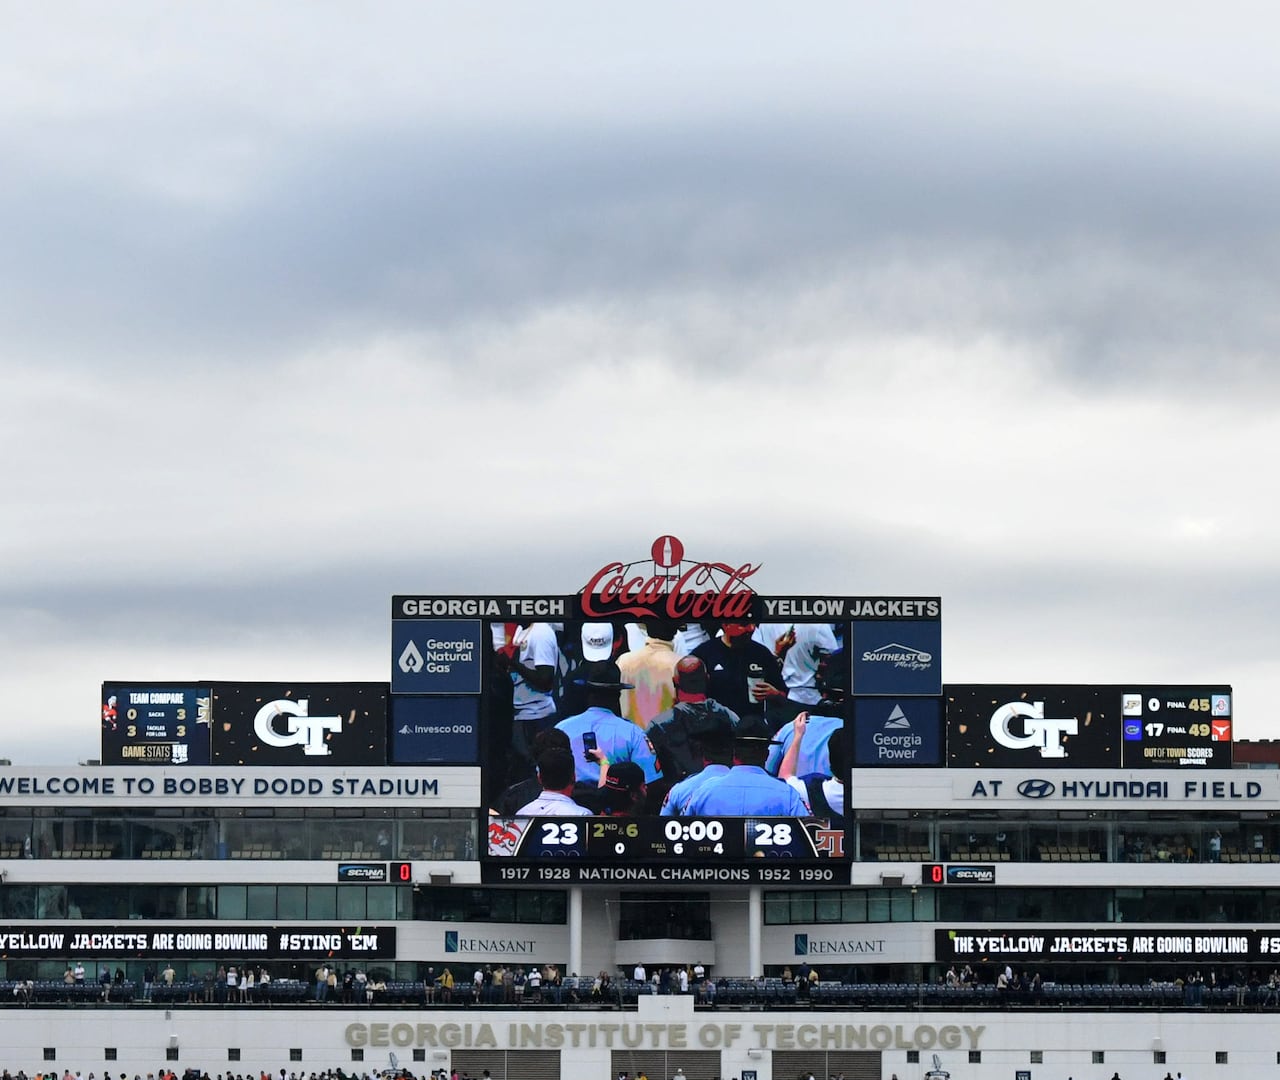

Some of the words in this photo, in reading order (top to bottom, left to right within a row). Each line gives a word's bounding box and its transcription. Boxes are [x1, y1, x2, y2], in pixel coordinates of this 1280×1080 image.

[402, 600, 500, 616] GEORGIA
[509, 600, 565, 616] TECH
[764, 600, 846, 617] YELLOW
[850, 600, 940, 617] JACKETS
[426, 639, 474, 651] Georgia
[426, 651, 473, 661] Natural
[426, 663, 450, 673] Gas
[130, 693, 150, 704] TEAM
[151, 693, 184, 704] COMPARE
[1148, 698, 1160, 711] 0
[1189, 699, 1210, 711] 45
[127, 709, 137, 720] 0
[177, 709, 186, 720] 3
[127, 725, 137, 737] 3
[177, 725, 186, 737] 3
[414, 725, 451, 734] Invesco
[452, 725, 473, 735] QQQ
[1145, 723, 1163, 737] 17
[1189, 724, 1210, 737] 49
[872, 733, 922, 748] Georgia
[122, 746, 145, 758] GAME
[146, 746, 170, 758] STATS
[879, 746, 917, 759] Power
[1144, 748, 1157, 758] OUT
[1157, 748, 1166, 758] OF
[1166, 748, 1186, 758] TOWN
[1187, 748, 1213, 758] SCORES
[122, 777, 155, 795] TO
[163, 777, 245, 796] BOBBY
[253, 778, 324, 796] DODD
[331, 778, 440, 797] STADIUM
[972, 780, 1003, 797] AT
[1062, 781, 1168, 798] HYUNDAI
[1185, 781, 1262, 798] FIELD
[541, 823, 578, 845] 23
[626, 823, 638, 838] 6
[665, 820, 724, 841] 0:00
[754, 823, 792, 845] 28
[615, 842, 625, 855] 0
[673, 842, 683, 855] 6
[714, 842, 724, 855] 4
[347, 869, 385, 877] SCANA
[400, 864, 409, 880] 0
[500, 868, 530, 880] 1917
[538, 868, 571, 880] 1928
[579, 868, 657, 880] NATIONAL
[660, 869, 750, 881] CHAMPIONS
[758, 869, 791, 881] 1952
[799, 869, 833, 881] 1990
[932, 866, 942, 882] 0
[956, 870, 993, 878] SCANA
[70, 933, 148, 951] JACKETS
[152, 933, 174, 951] ARE
[176, 933, 212, 951] GOING
[215, 933, 268, 951] BOWLING
[279, 933, 342, 951] #STING
[460, 940, 537, 952] RENASANT
[810, 940, 887, 952] RENASANT
[953, 937, 973, 953] THE
[976, 937, 1044, 954] YELLOW
[1050, 937, 1128, 954] JACKETS
[1132, 936, 1154, 953] ARE
[1156, 936, 1192, 953] GOING
[1194, 936, 1248, 953] BOWLING
[345, 1022, 498, 1048] GEORGIA
[509, 1022, 687, 1048] INSTITUTE
[699, 1023, 741, 1049] OF
[751, 1024, 986, 1050] TECHNOLOGY
